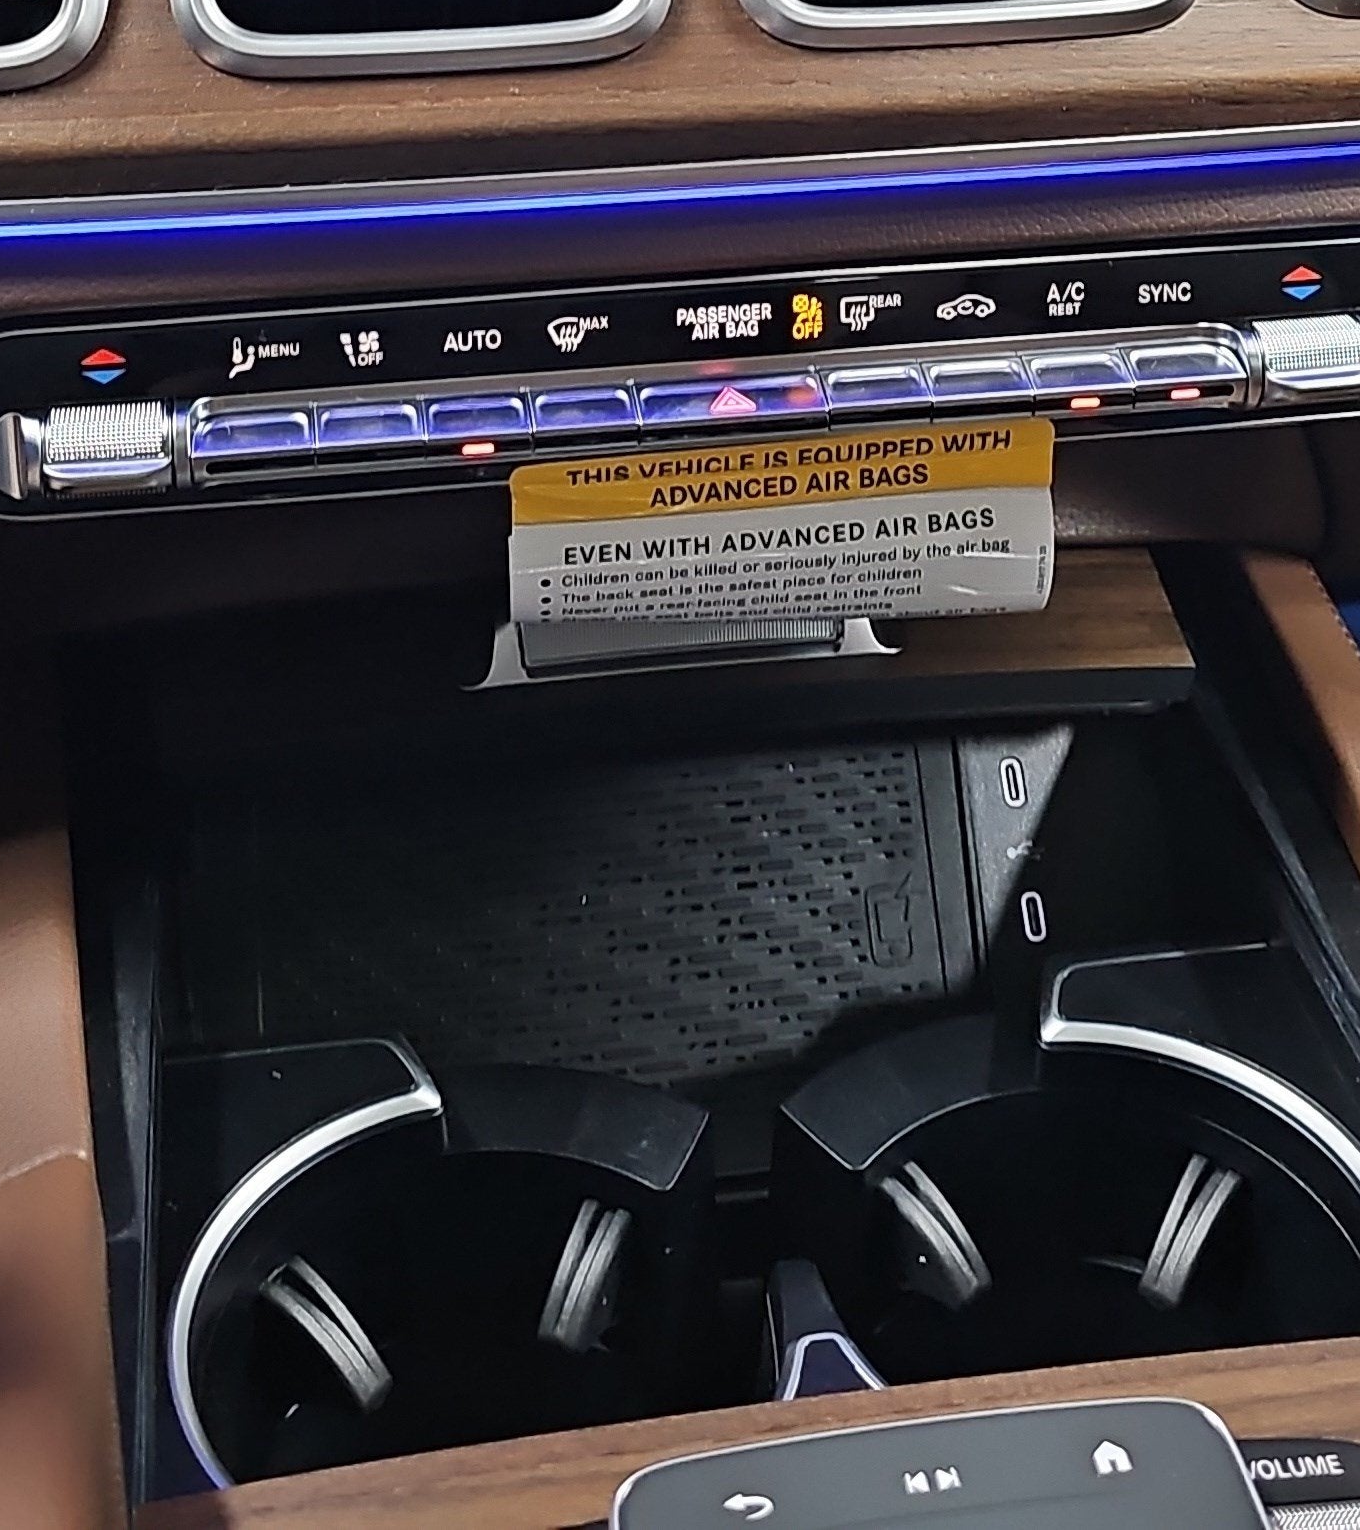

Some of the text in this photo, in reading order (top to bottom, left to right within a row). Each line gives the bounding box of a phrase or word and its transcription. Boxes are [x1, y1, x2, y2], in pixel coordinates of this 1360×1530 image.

[869, 292, 902, 309] REAR
[1046, 281, 1085, 303] A/C
[1137, 281, 1192, 304] SYNC
[675, 303, 773, 327] PASSENGER
[1048, 300, 1081, 316] REST
[579, 315, 609, 331] MAX
[691, 319, 760, 341] AIR BAG
[792, 321, 824, 340] OFF
[257, 342, 300, 359] MENU
[443, 328, 502, 353] AUTO
[356, 351, 384, 367] OFF
[566, 429, 1011, 487] THIS VEHICLE IS EQUIPPED WITH
[650, 463, 930, 508] ADVANCED AIR BAGS
[564, 507, 995, 566] EVEN WITH ADVANCED AIR BAGS
[561, 537, 1011, 588] Children can be killed or seriously injured by the air bag
[561, 593, 591, 604] The
[596, 588, 634, 602] back
[782, 574, 826, 591] place
[830, 571, 853, 585] for
[857, 568, 922, 583] children
